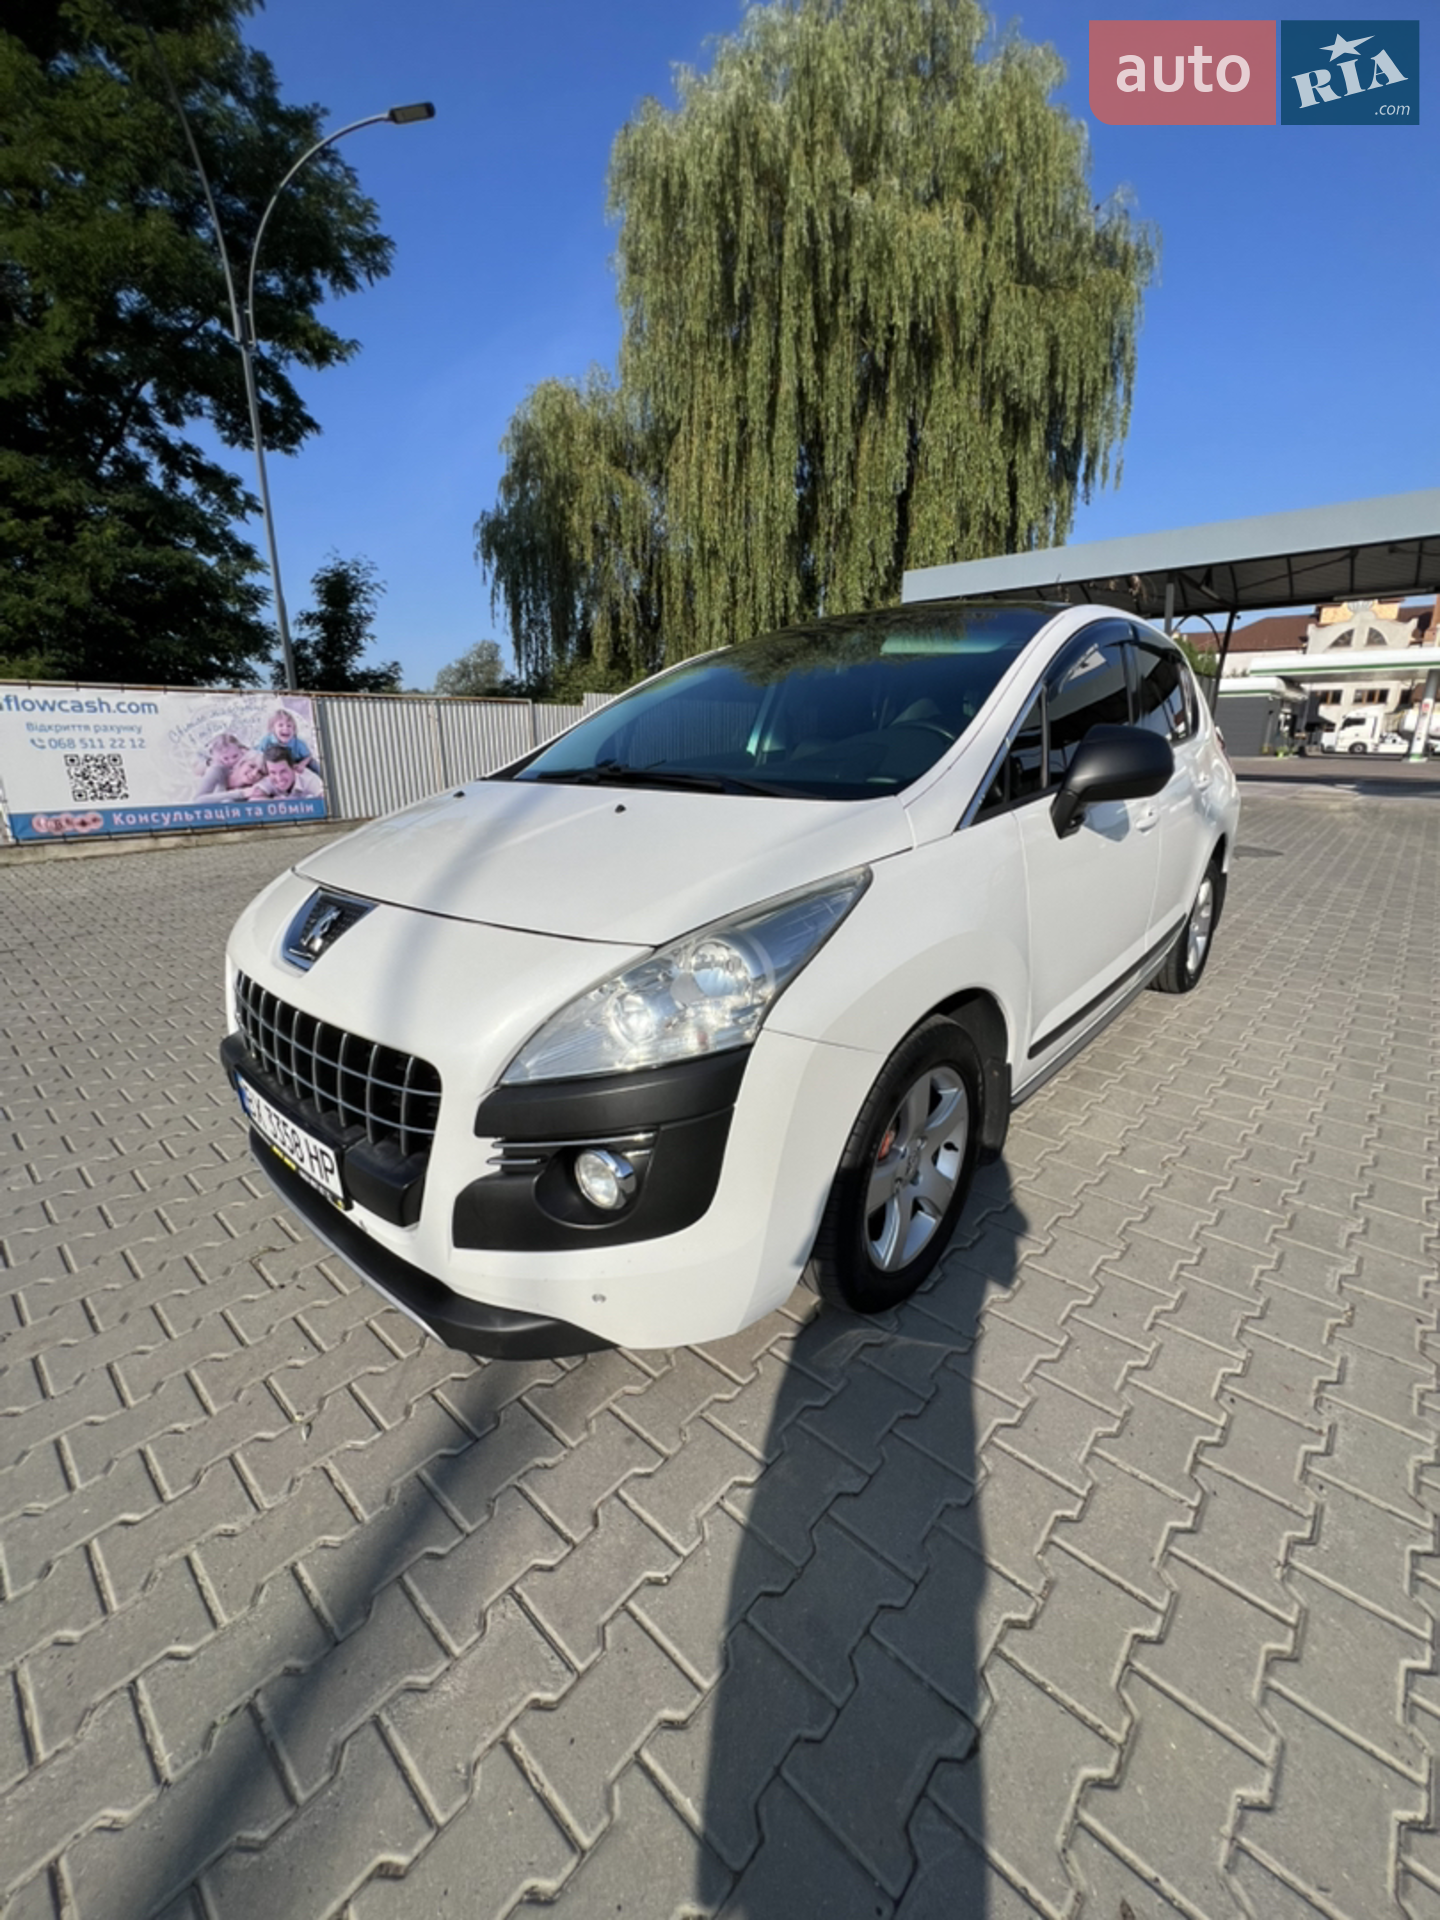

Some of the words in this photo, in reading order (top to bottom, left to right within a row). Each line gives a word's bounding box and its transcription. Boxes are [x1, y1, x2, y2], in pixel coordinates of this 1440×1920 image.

[26, 722, 91, 734] Відкриття
[94, 725, 143, 734] рахунку
[48, 738, 76, 750] 068
[79, 738, 105, 750] 511
[109, 738, 126, 750] 22
[129, 738, 146, 750] 12
[112, 806, 242, 826] Консультація
[245, 806, 263, 817] та
[267, 802, 314, 816] Обмін
[304, 1138, 335, 1183] HP
